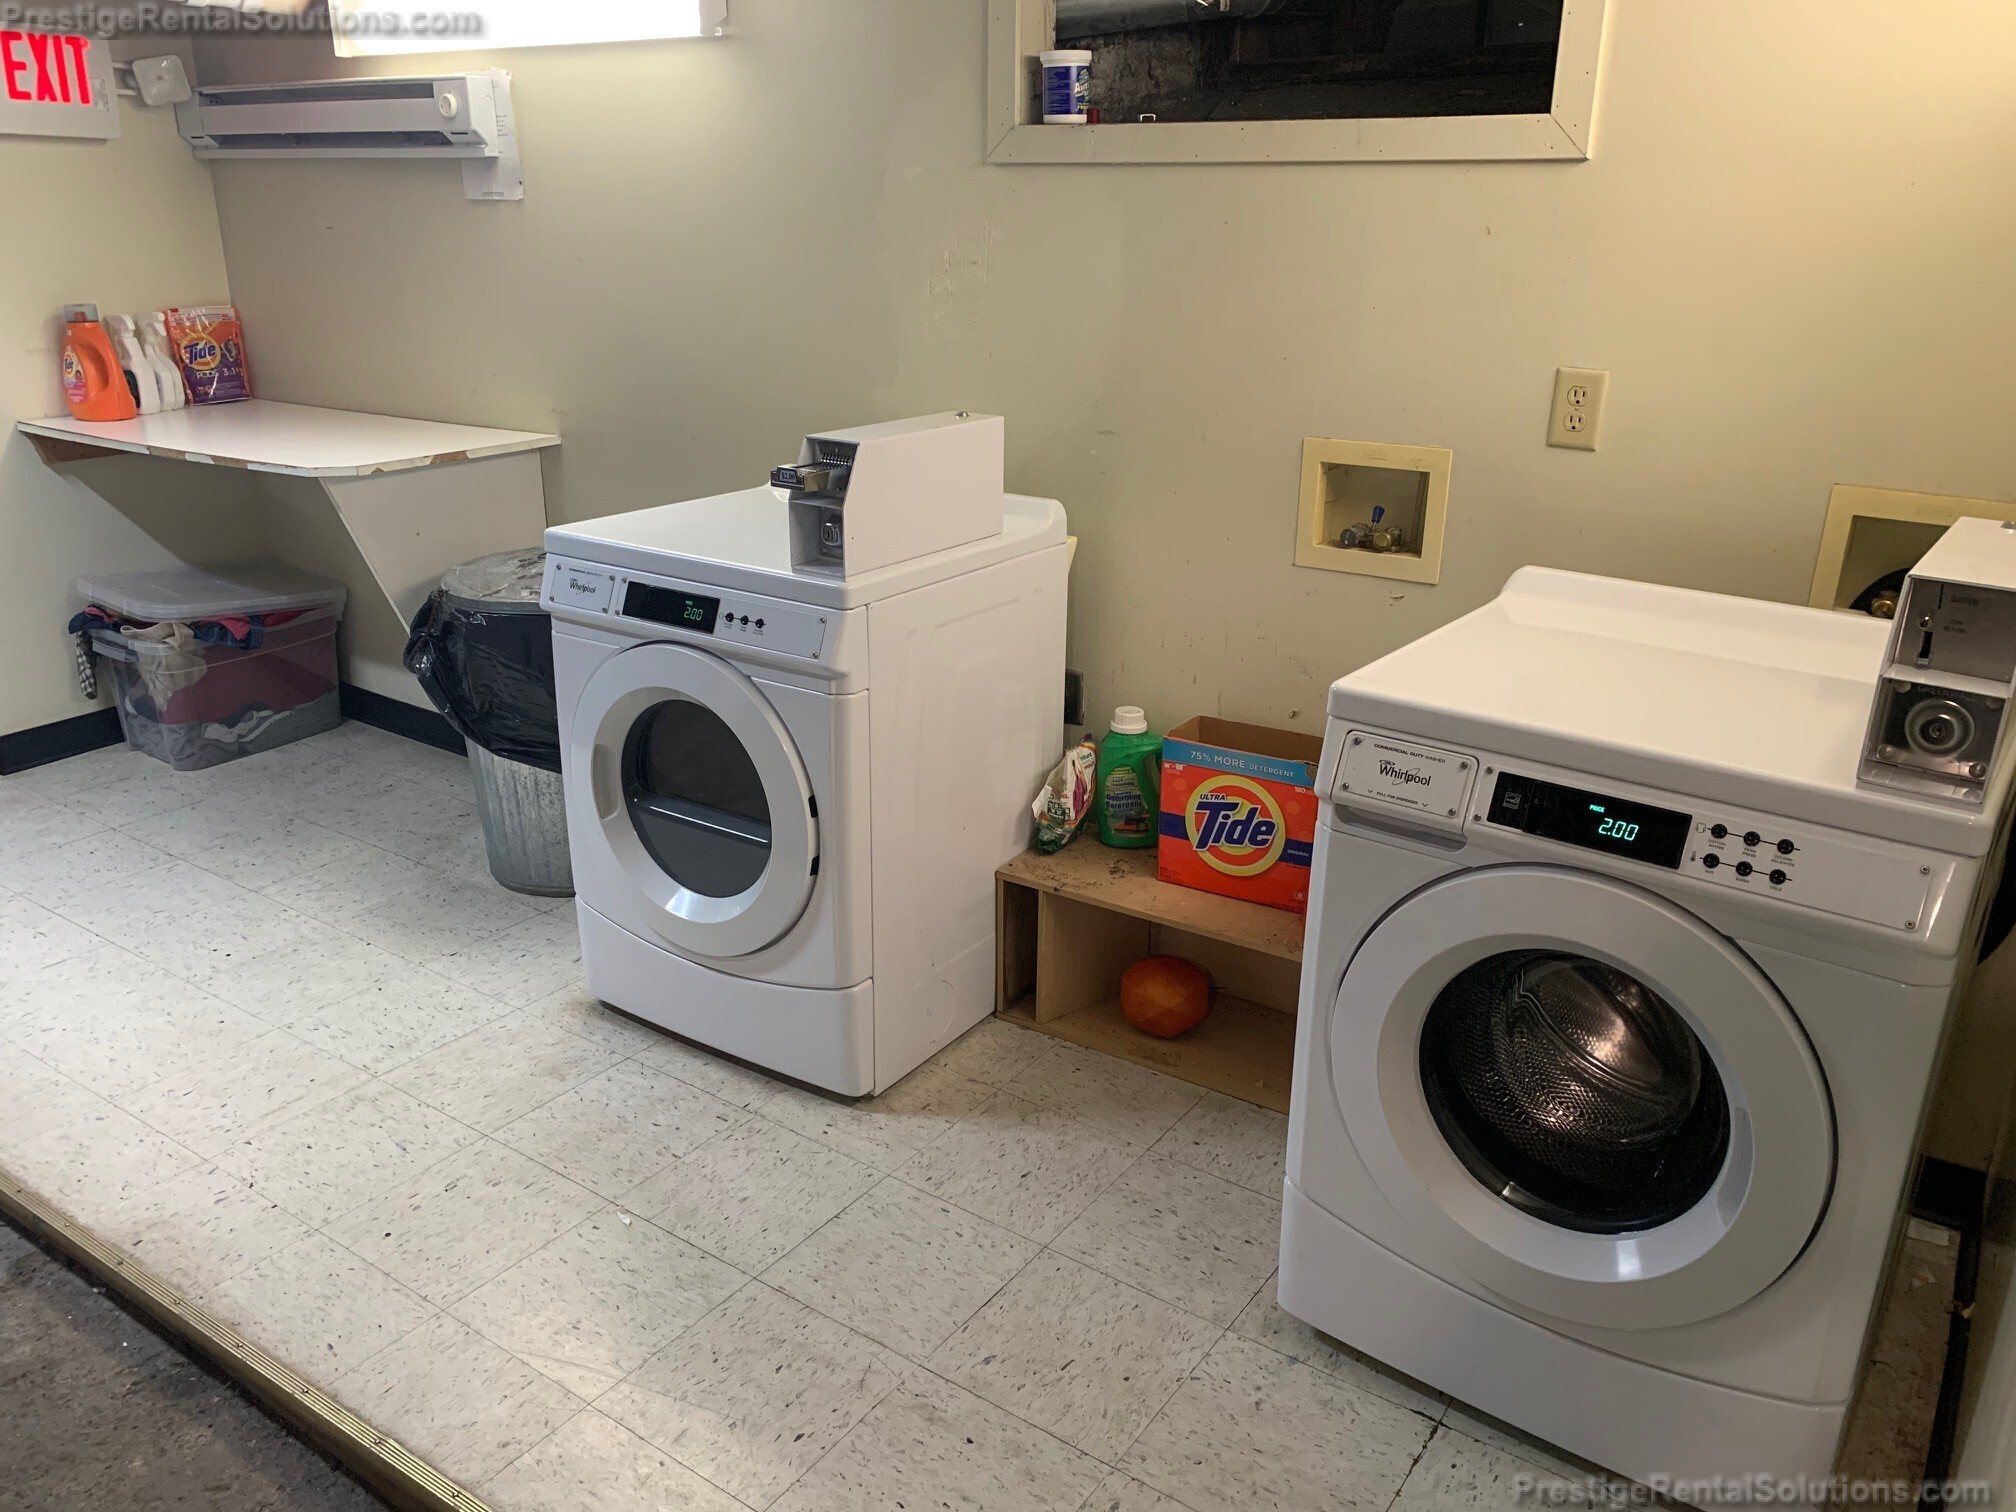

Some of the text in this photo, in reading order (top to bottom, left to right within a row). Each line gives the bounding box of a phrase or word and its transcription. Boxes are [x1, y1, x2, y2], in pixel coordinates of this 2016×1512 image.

[0, 30, 90, 105] EXIT
[184, 341, 216, 366] Tide
[570, 581, 597, 594] Whirlpool
[1190, 750, 1295, 778] 75% MORE DETERGENT
[1373, 743, 1446, 763] COMMERCIAL DUTY WASHER
[1379, 763, 1431, 786] Whirlpool
[1199, 793, 1227, 801] ULTRA
[1195, 801, 1277, 850] Tide
[1599, 817, 1639, 841] 2.00
[1287, 849, 1310, 857] ORIGINAL
